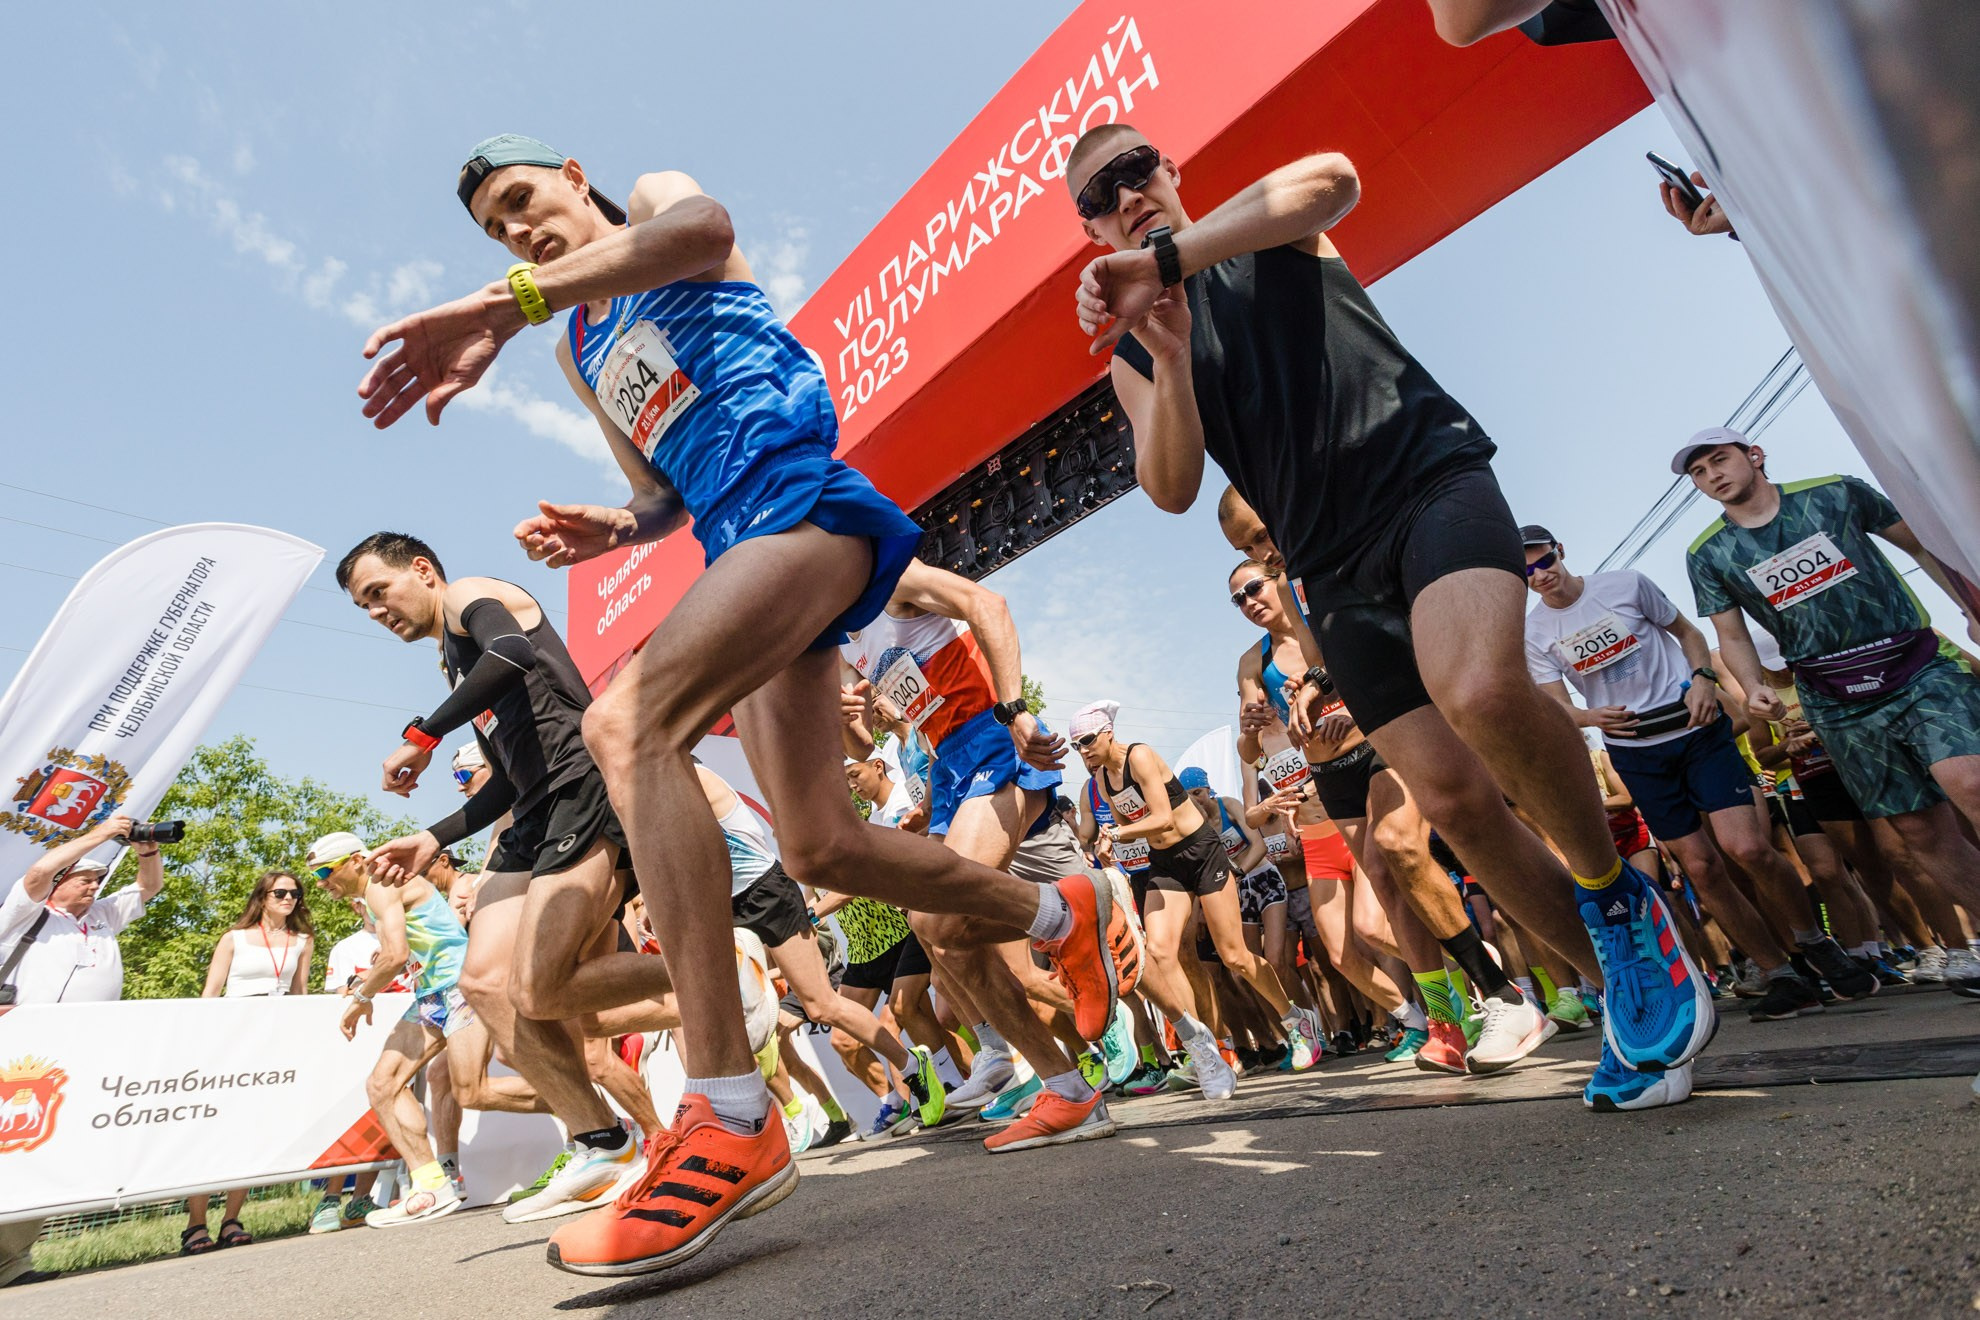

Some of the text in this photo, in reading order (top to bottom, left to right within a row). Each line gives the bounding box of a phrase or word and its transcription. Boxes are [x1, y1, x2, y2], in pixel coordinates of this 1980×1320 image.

[833, 15, 1143, 339] VII ПАРИЖСКИЙ
[839, 52, 1160, 383] ПОЛУМАРАФОН
[616, 359, 660, 427] 2264
[840, 336, 910, 423] 2023
[748, 507, 774, 528] AY
[598, 539, 664, 600] Челябин
[1766, 550, 1831, 591] 2004
[597, 573, 652, 635] область
[88, 556, 217, 732] ПРИ ПОДДЕРЖКЕ ГУБЕРНАТОРА
[1574, 628, 1618, 659] 2015
[115, 601, 216, 739] ЧЕЛЯБИНСКОЙ ОБЛАСТИ
[1846, 680, 1880, 694] PUMA
[1270, 757, 1303, 781] 2365
[910, 787, 924, 805] 55
[1123, 846, 1148, 859] 2314
[1222, 839, 1235, 850] 12
[1267, 841, 1288, 854] 302
[1607, 908, 1628, 917] adidas
[101, 1069, 296, 1098] Челябинская
[91, 1103, 218, 1129] область
